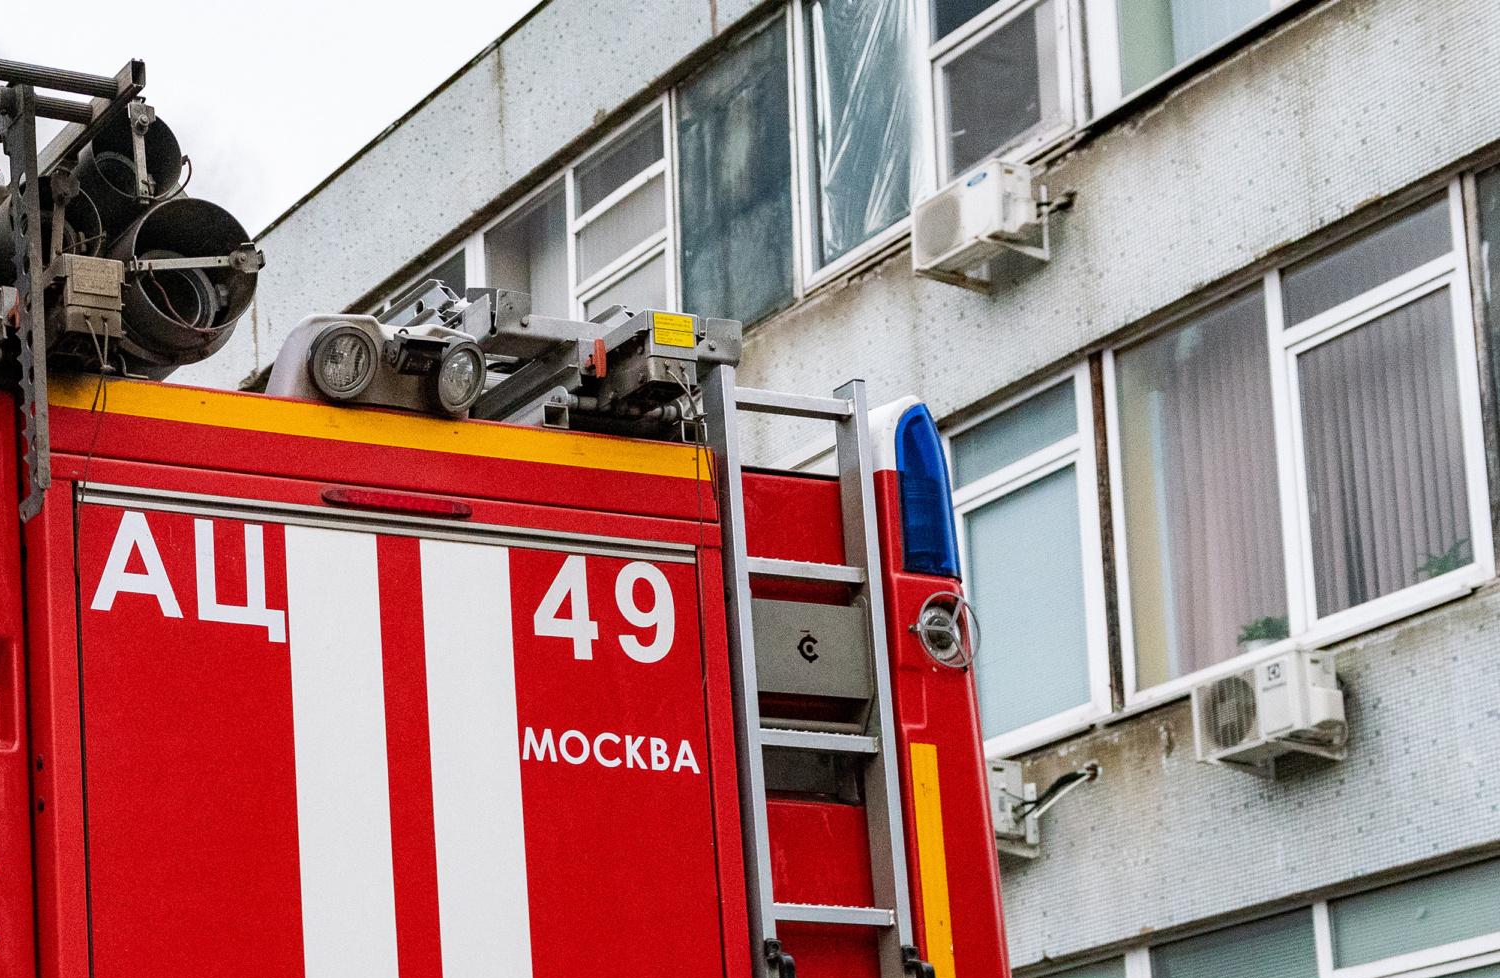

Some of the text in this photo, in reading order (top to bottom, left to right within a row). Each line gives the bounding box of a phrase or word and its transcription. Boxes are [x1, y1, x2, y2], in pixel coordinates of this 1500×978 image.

[90, 510, 287, 644] АЦ
[533, 554, 677, 664] 49
[522, 726, 702, 774] МОСКВА
